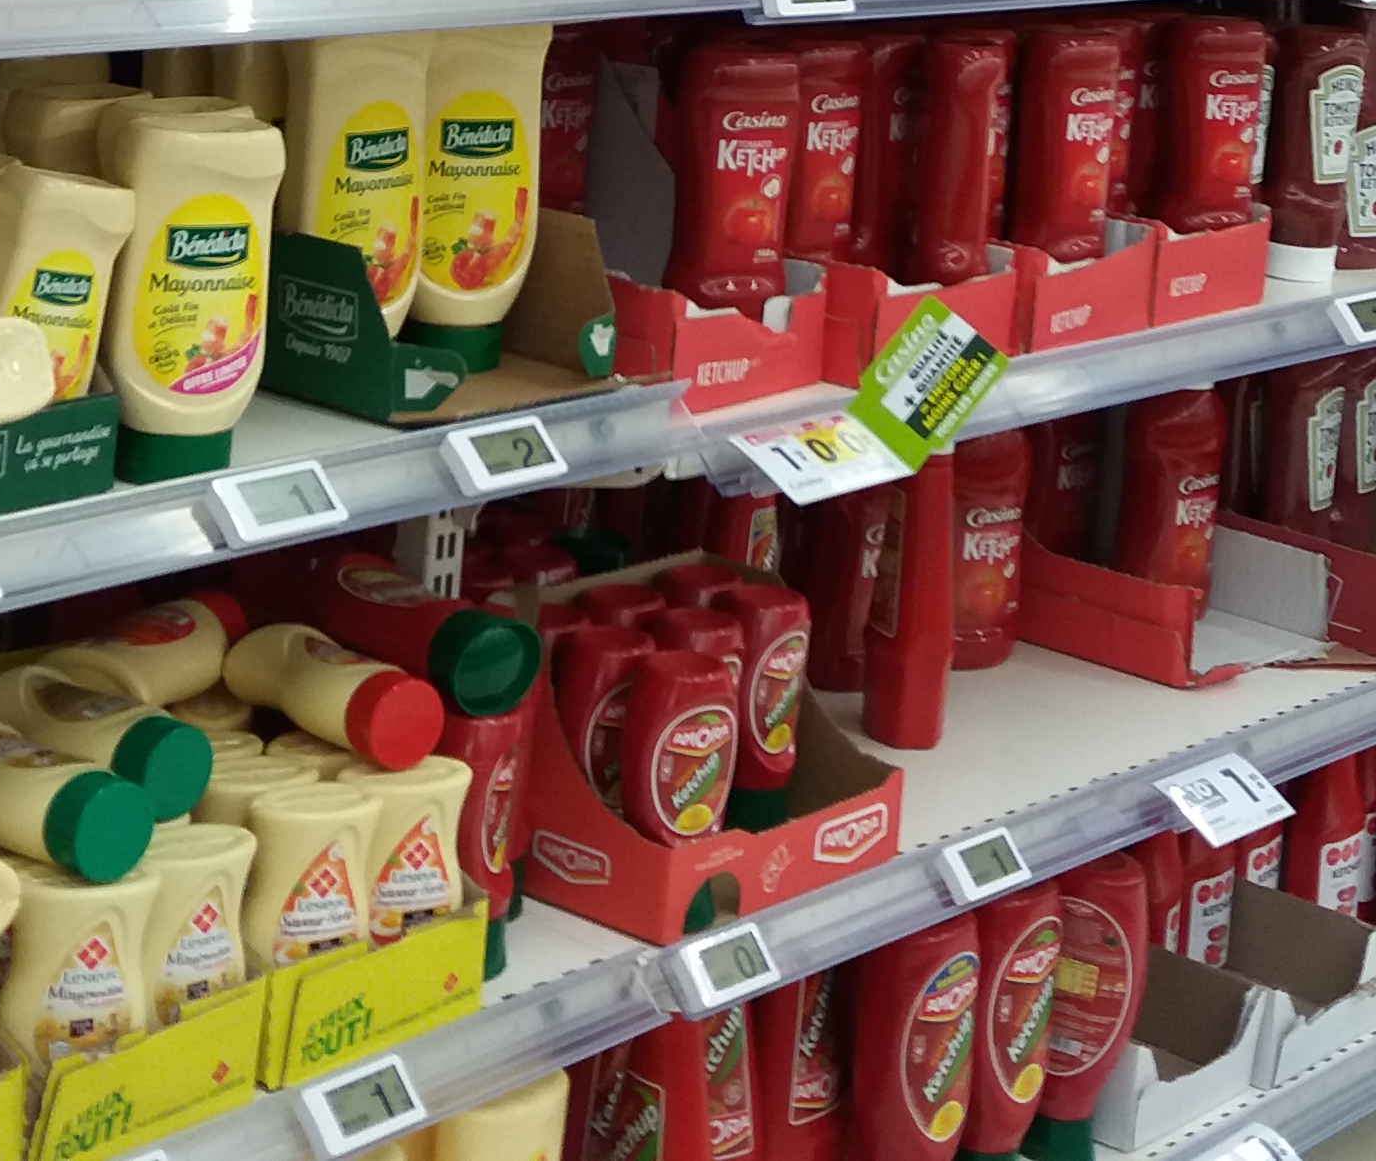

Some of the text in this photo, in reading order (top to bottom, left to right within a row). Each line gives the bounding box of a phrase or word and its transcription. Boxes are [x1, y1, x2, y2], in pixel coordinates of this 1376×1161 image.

[1209, 70, 1258, 88] Casino
[811, 94, 860, 113] Casino
[1070, 88, 1114, 107] Casino
[723, 110, 787, 131] Casino
[446, 123, 512, 150] Bénédicta
[348, 136, 407, 167] Bénédicta
[427, 160, 521, 179] Mayonnaise
[171, 228, 249, 258] Bénédicta
[148, 272, 255, 296] Mayonnaise
[1049, 304, 1092, 334] KETCHUP
[697, 357, 751, 387] KETCHUP
[512, 437, 533, 468] 2
[771, 447, 802, 471] 1
[370, 1084, 394, 1117] 1
